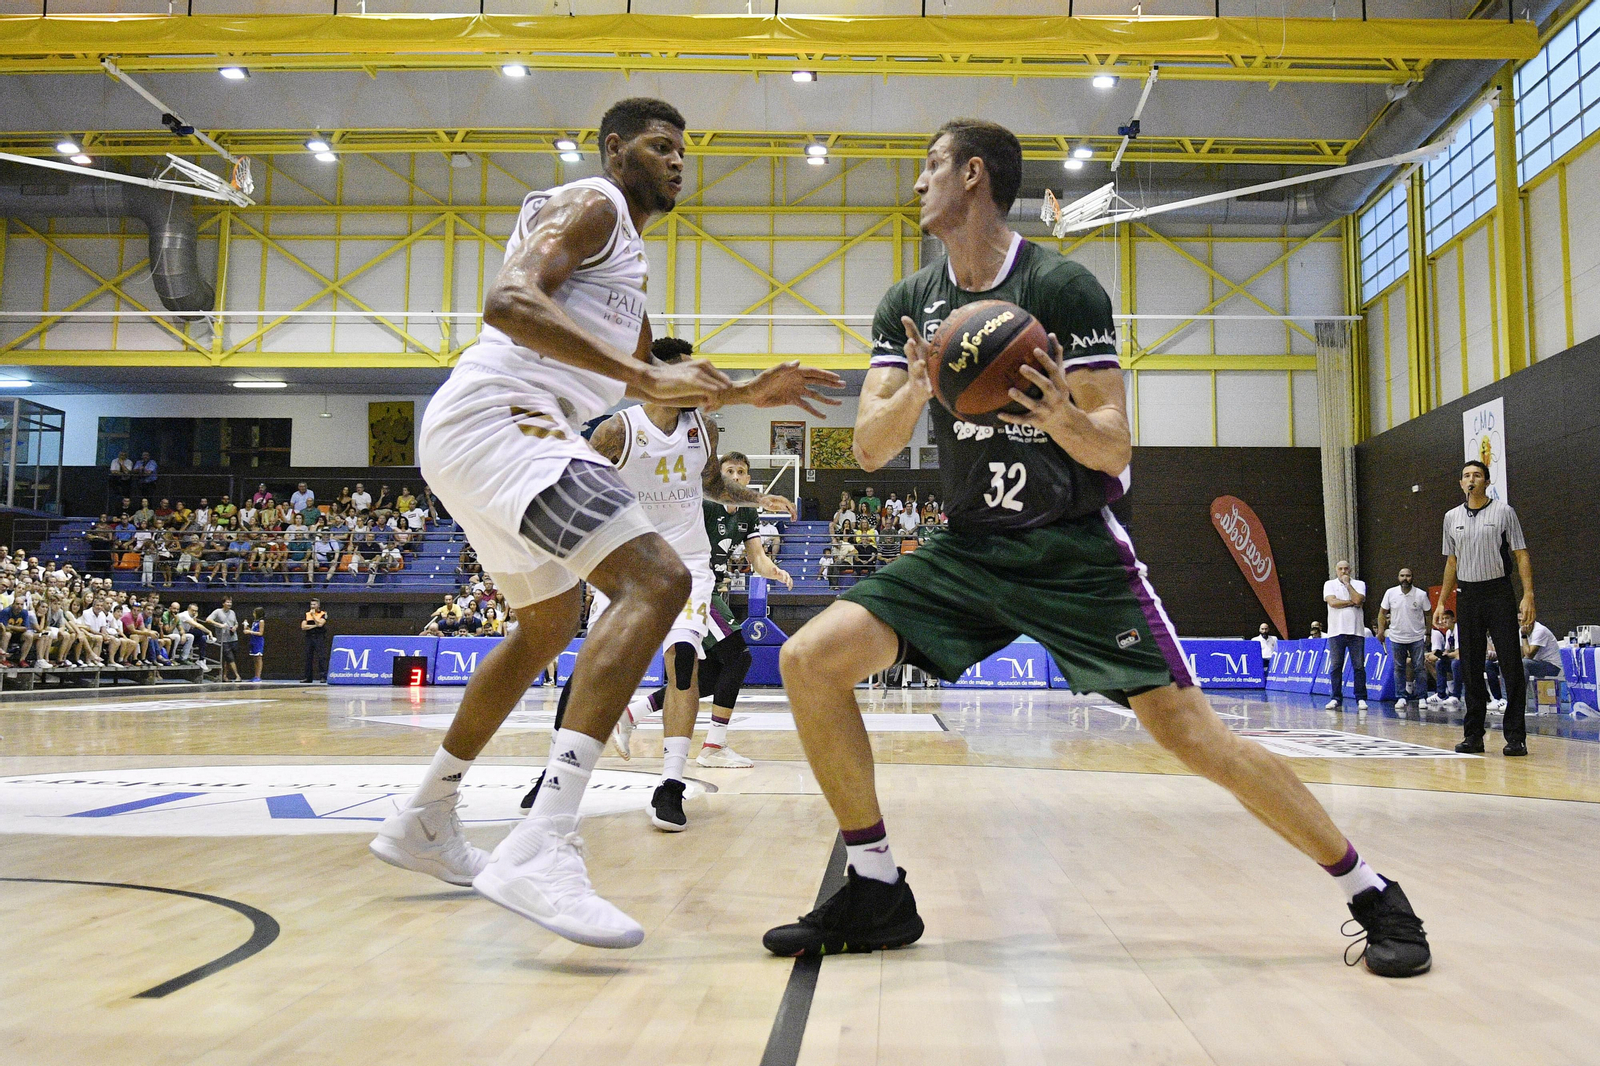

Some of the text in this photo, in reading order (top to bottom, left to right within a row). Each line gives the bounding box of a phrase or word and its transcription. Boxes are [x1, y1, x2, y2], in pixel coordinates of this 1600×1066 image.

[655, 454, 687, 483] 44
[983, 462, 1027, 511] 32
[410, 669, 421, 685] 3
